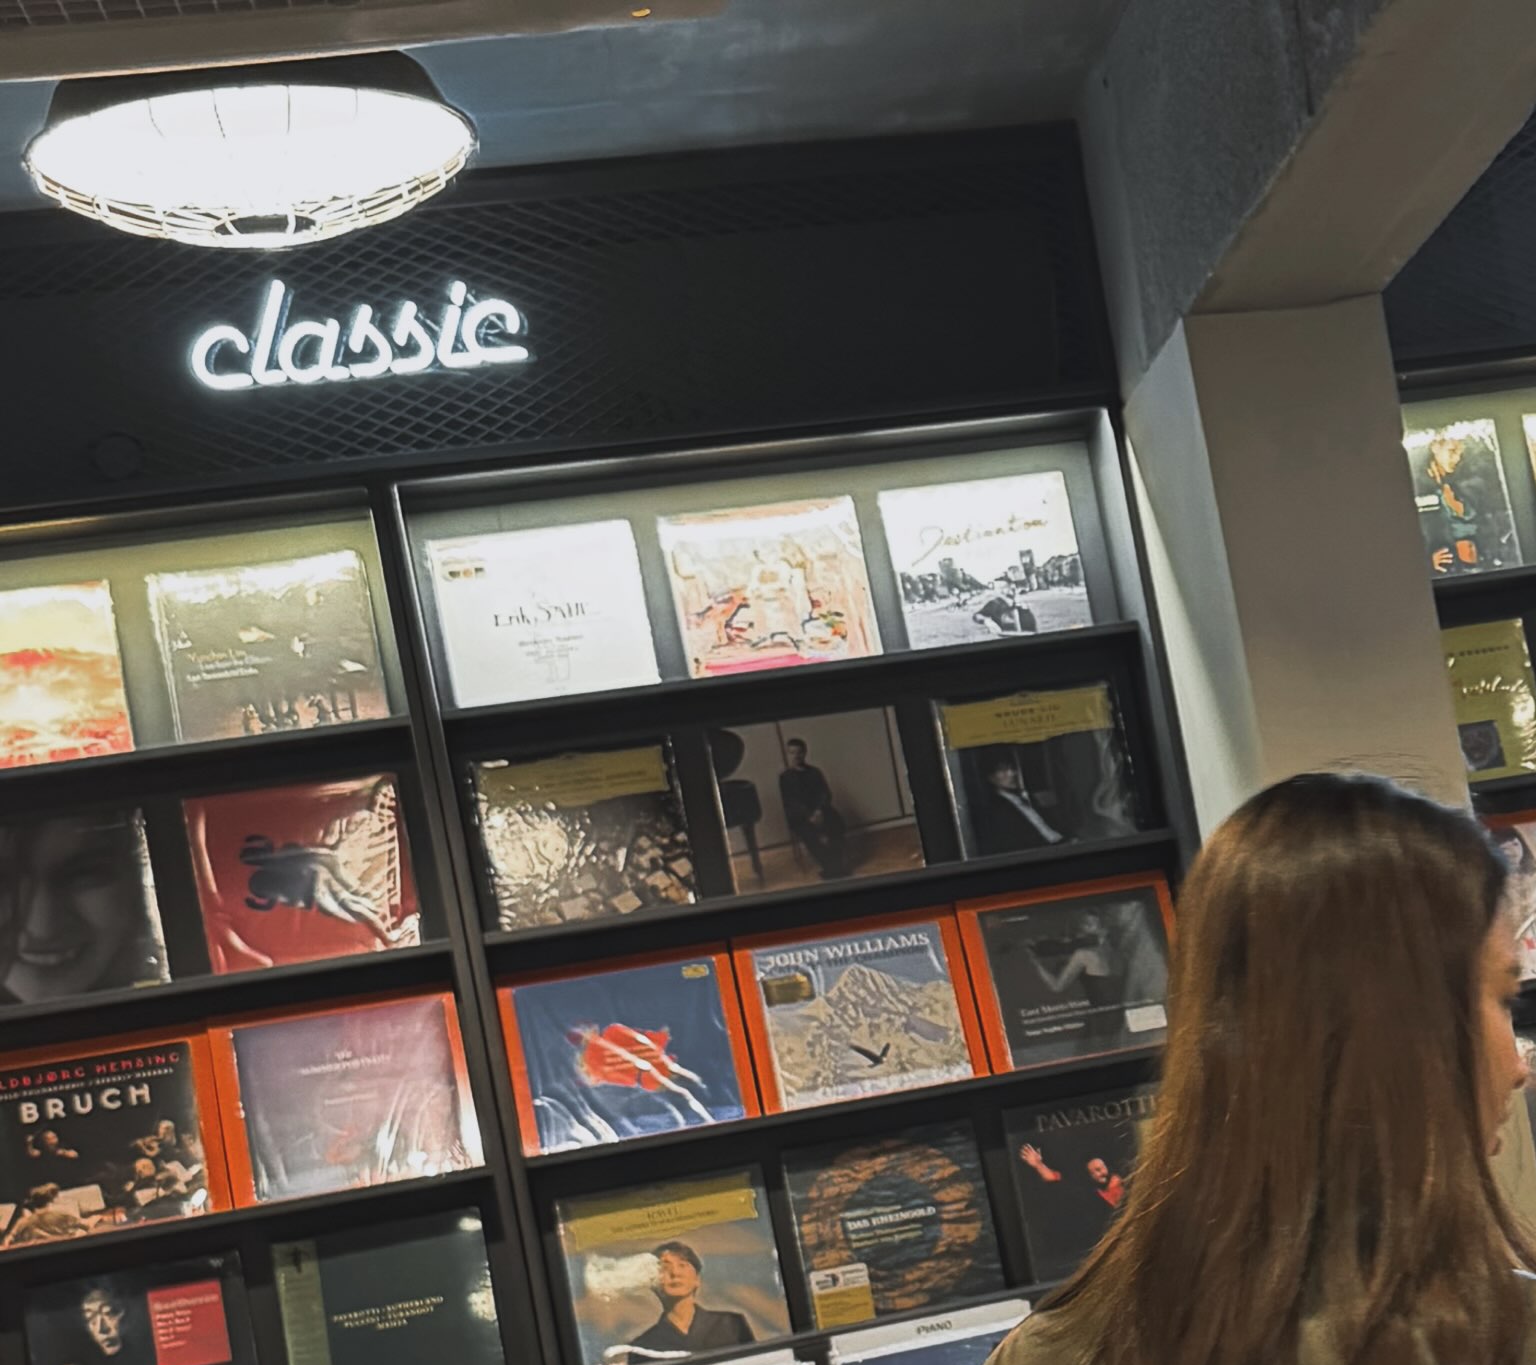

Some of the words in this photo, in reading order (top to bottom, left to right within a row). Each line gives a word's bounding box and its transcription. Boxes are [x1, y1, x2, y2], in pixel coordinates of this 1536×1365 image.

[190, 278, 531, 391] classic
[762, 947, 821, 972] JOHN
[824, 929, 931, 964] WILLIAMS
[19, 1081, 152, 1125] BRUCH
[1036, 1094, 1158, 1133] PAVAROTTI
[916, 1319, 953, 1336] PIANO
